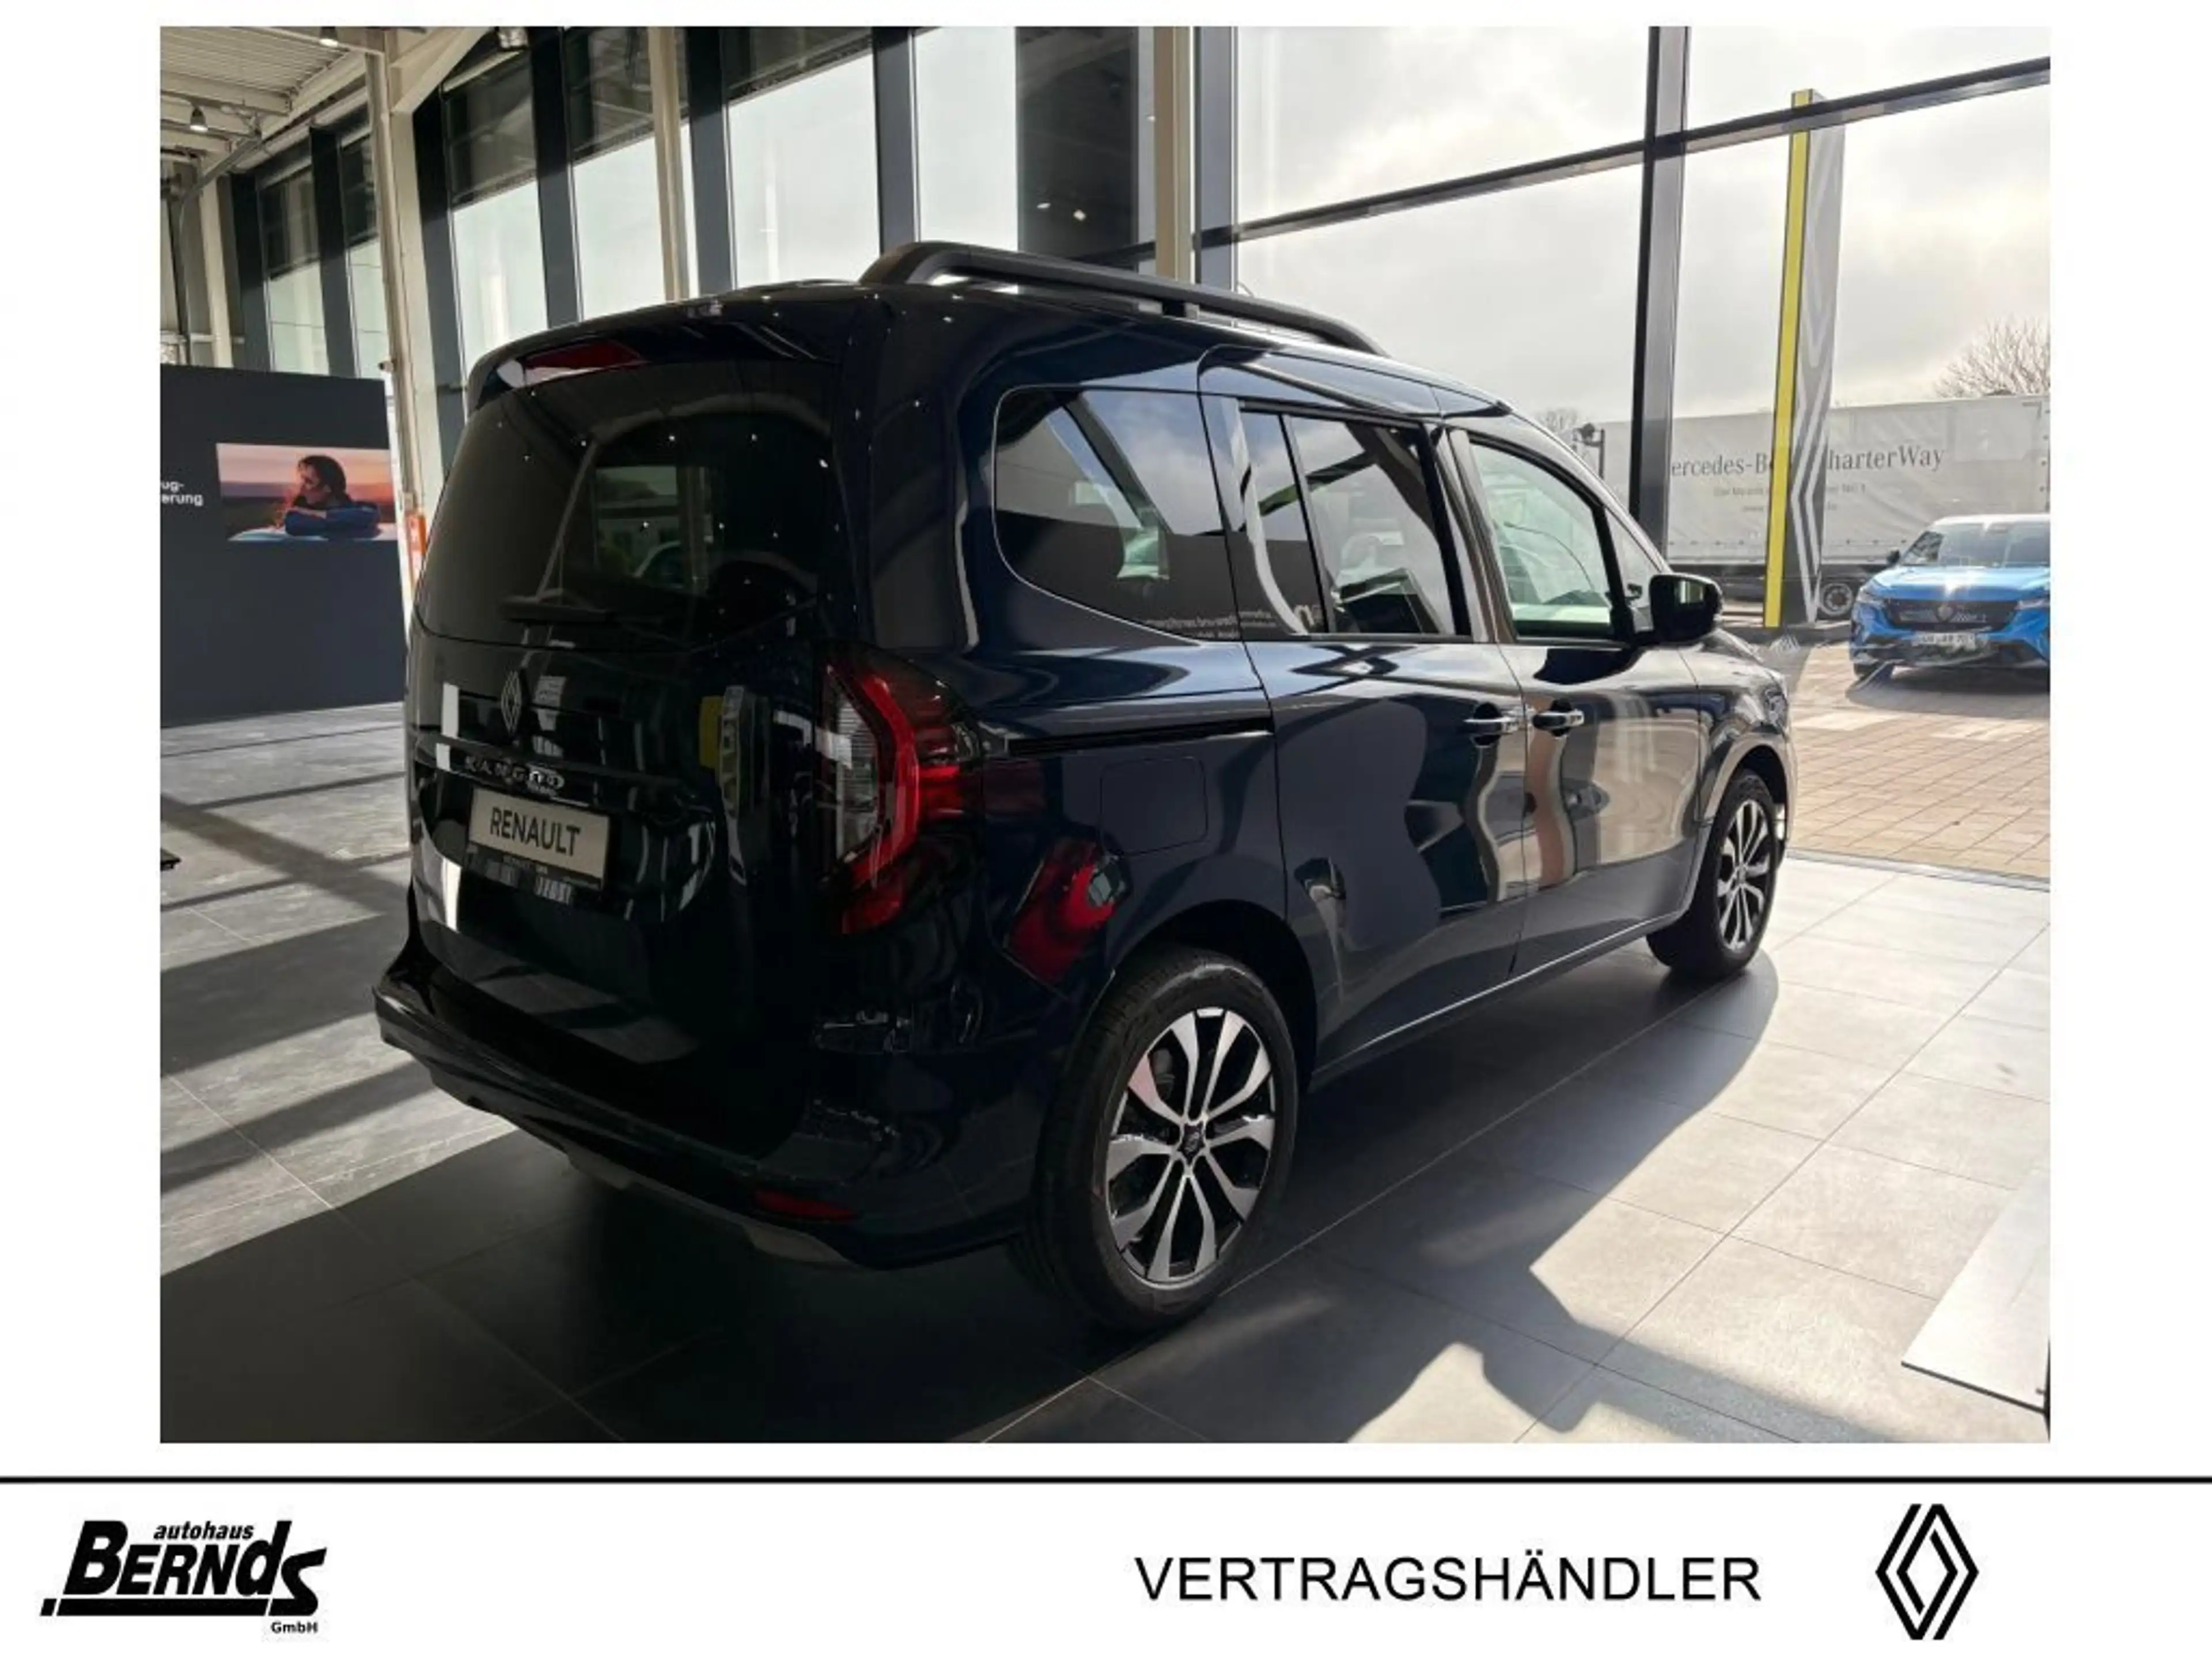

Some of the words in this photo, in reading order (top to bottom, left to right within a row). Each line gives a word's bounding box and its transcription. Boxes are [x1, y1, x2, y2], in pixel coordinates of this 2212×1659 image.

[1672, 451, 1772, 476] ercedes-B
[1827, 444, 1944, 472] harterWay
[160, 481, 184, 493] ug-
[161, 494, 204, 506] erung
[490, 807, 581, 857] RENAULT
